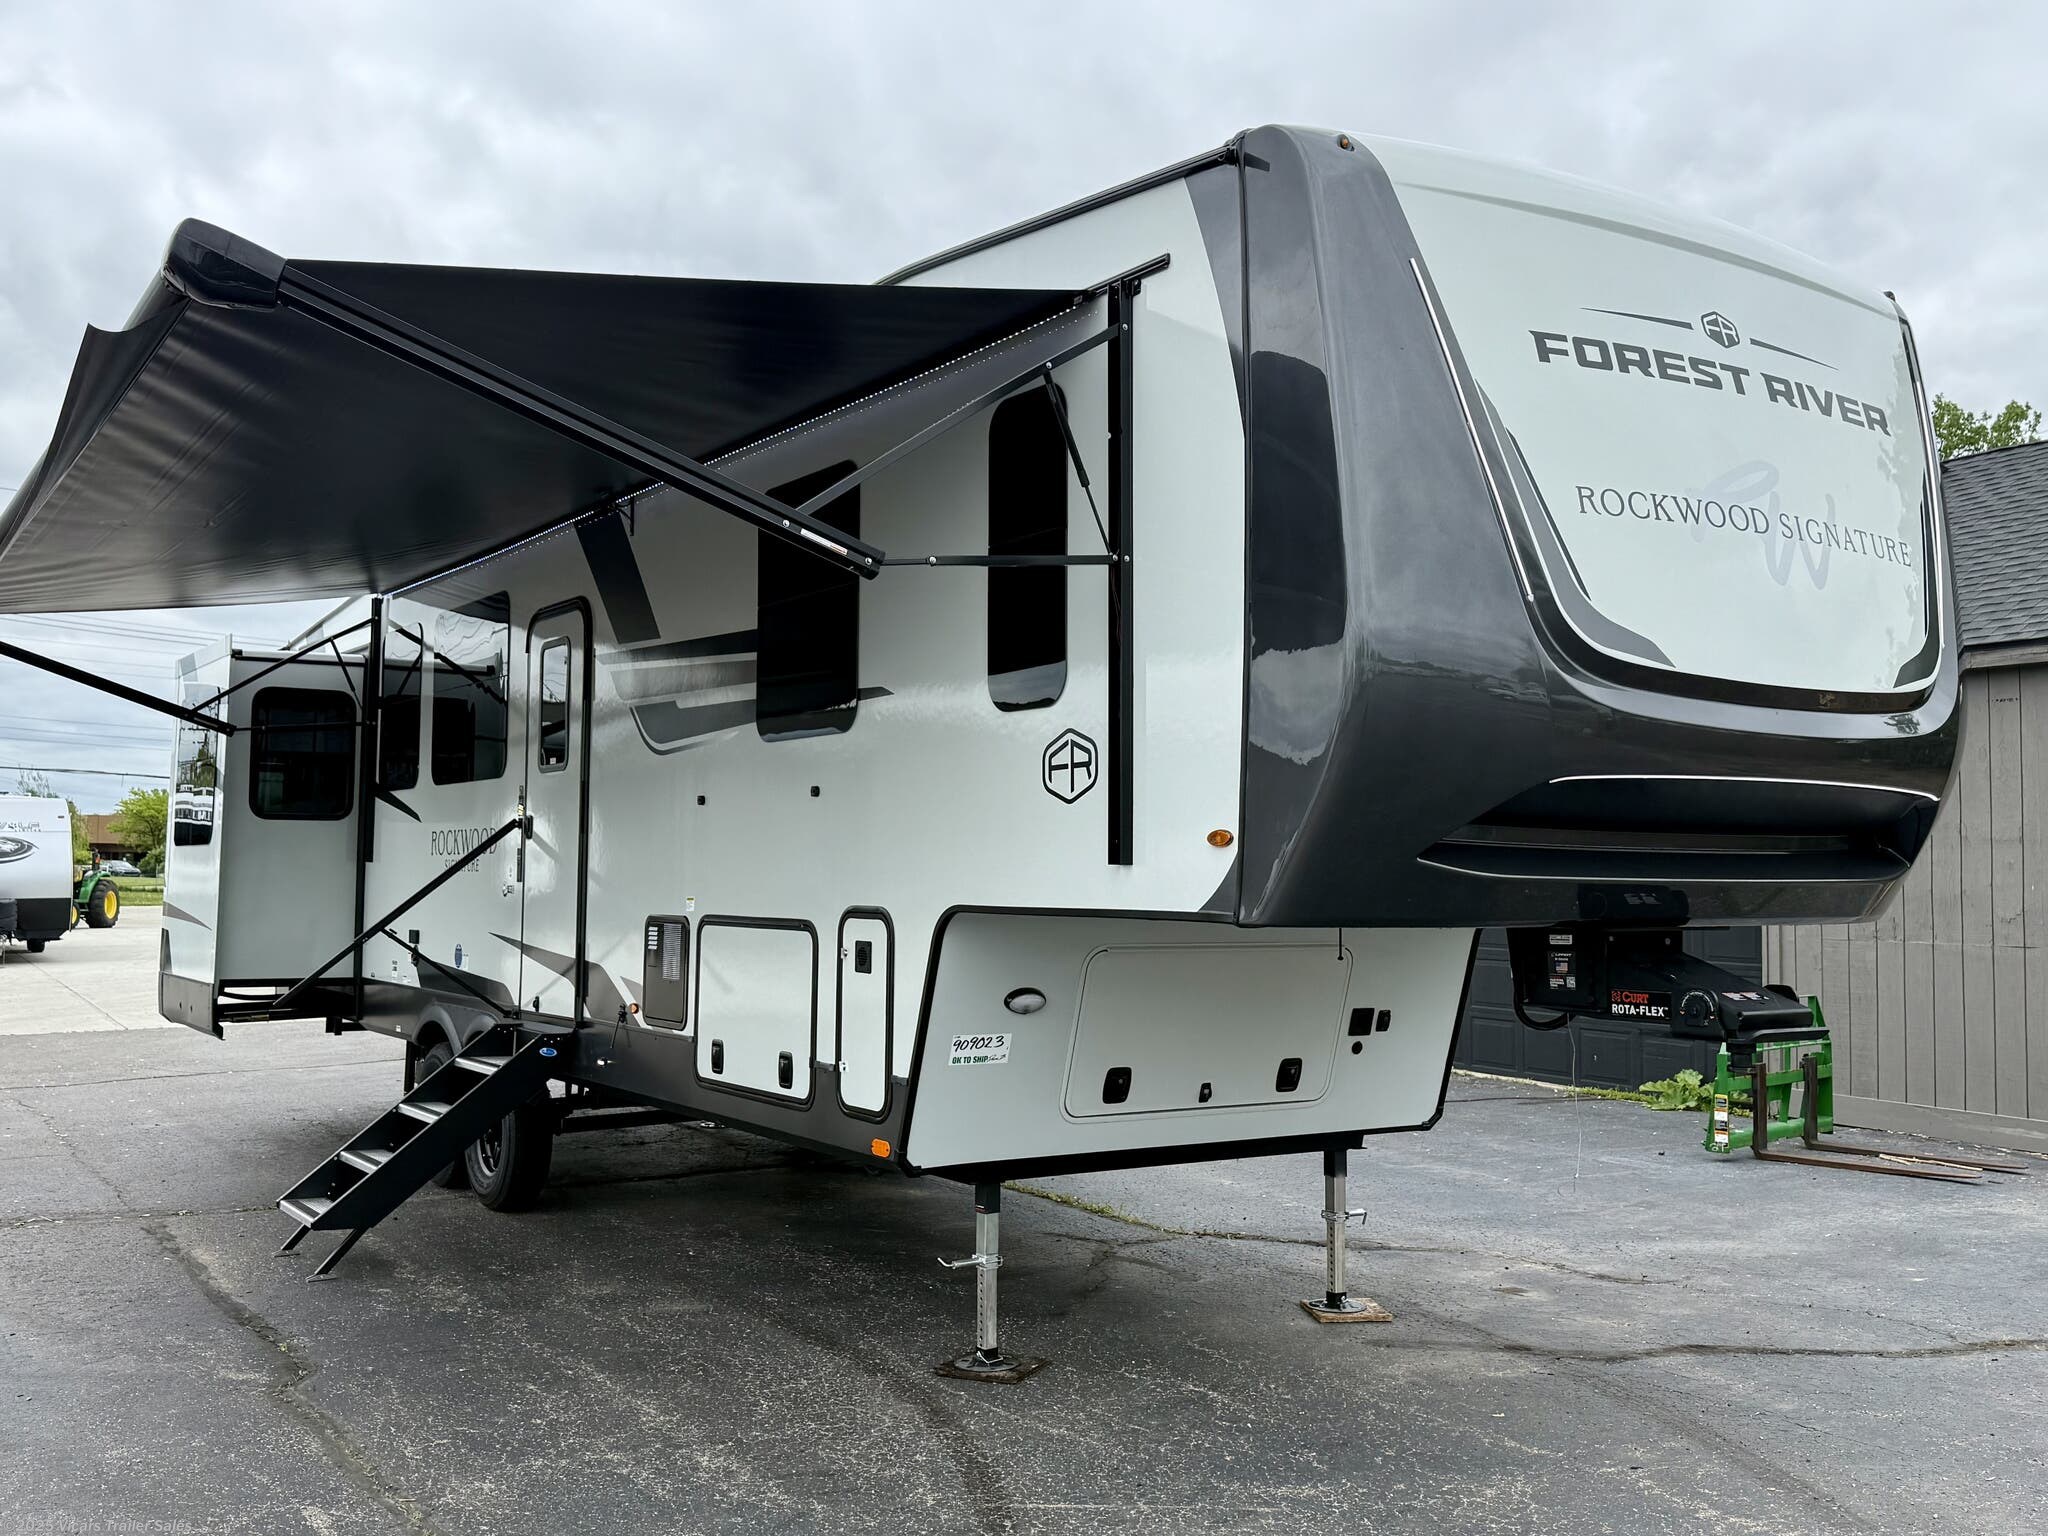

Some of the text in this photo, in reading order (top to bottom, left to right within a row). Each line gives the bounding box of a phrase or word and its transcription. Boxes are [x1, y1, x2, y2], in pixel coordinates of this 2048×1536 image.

[1528, 329, 1892, 437] FOREST RIVER
[1575, 485, 1913, 568] ROCKWOOD SIGNATURE
[1622, 991, 1649, 1004] CURT
[952, 1035, 1005, 1053] 909023
[951, 1056, 962, 1065] OK
[963, 1056, 972, 1064] TO
[972, 1055, 989, 1064] SHIP
